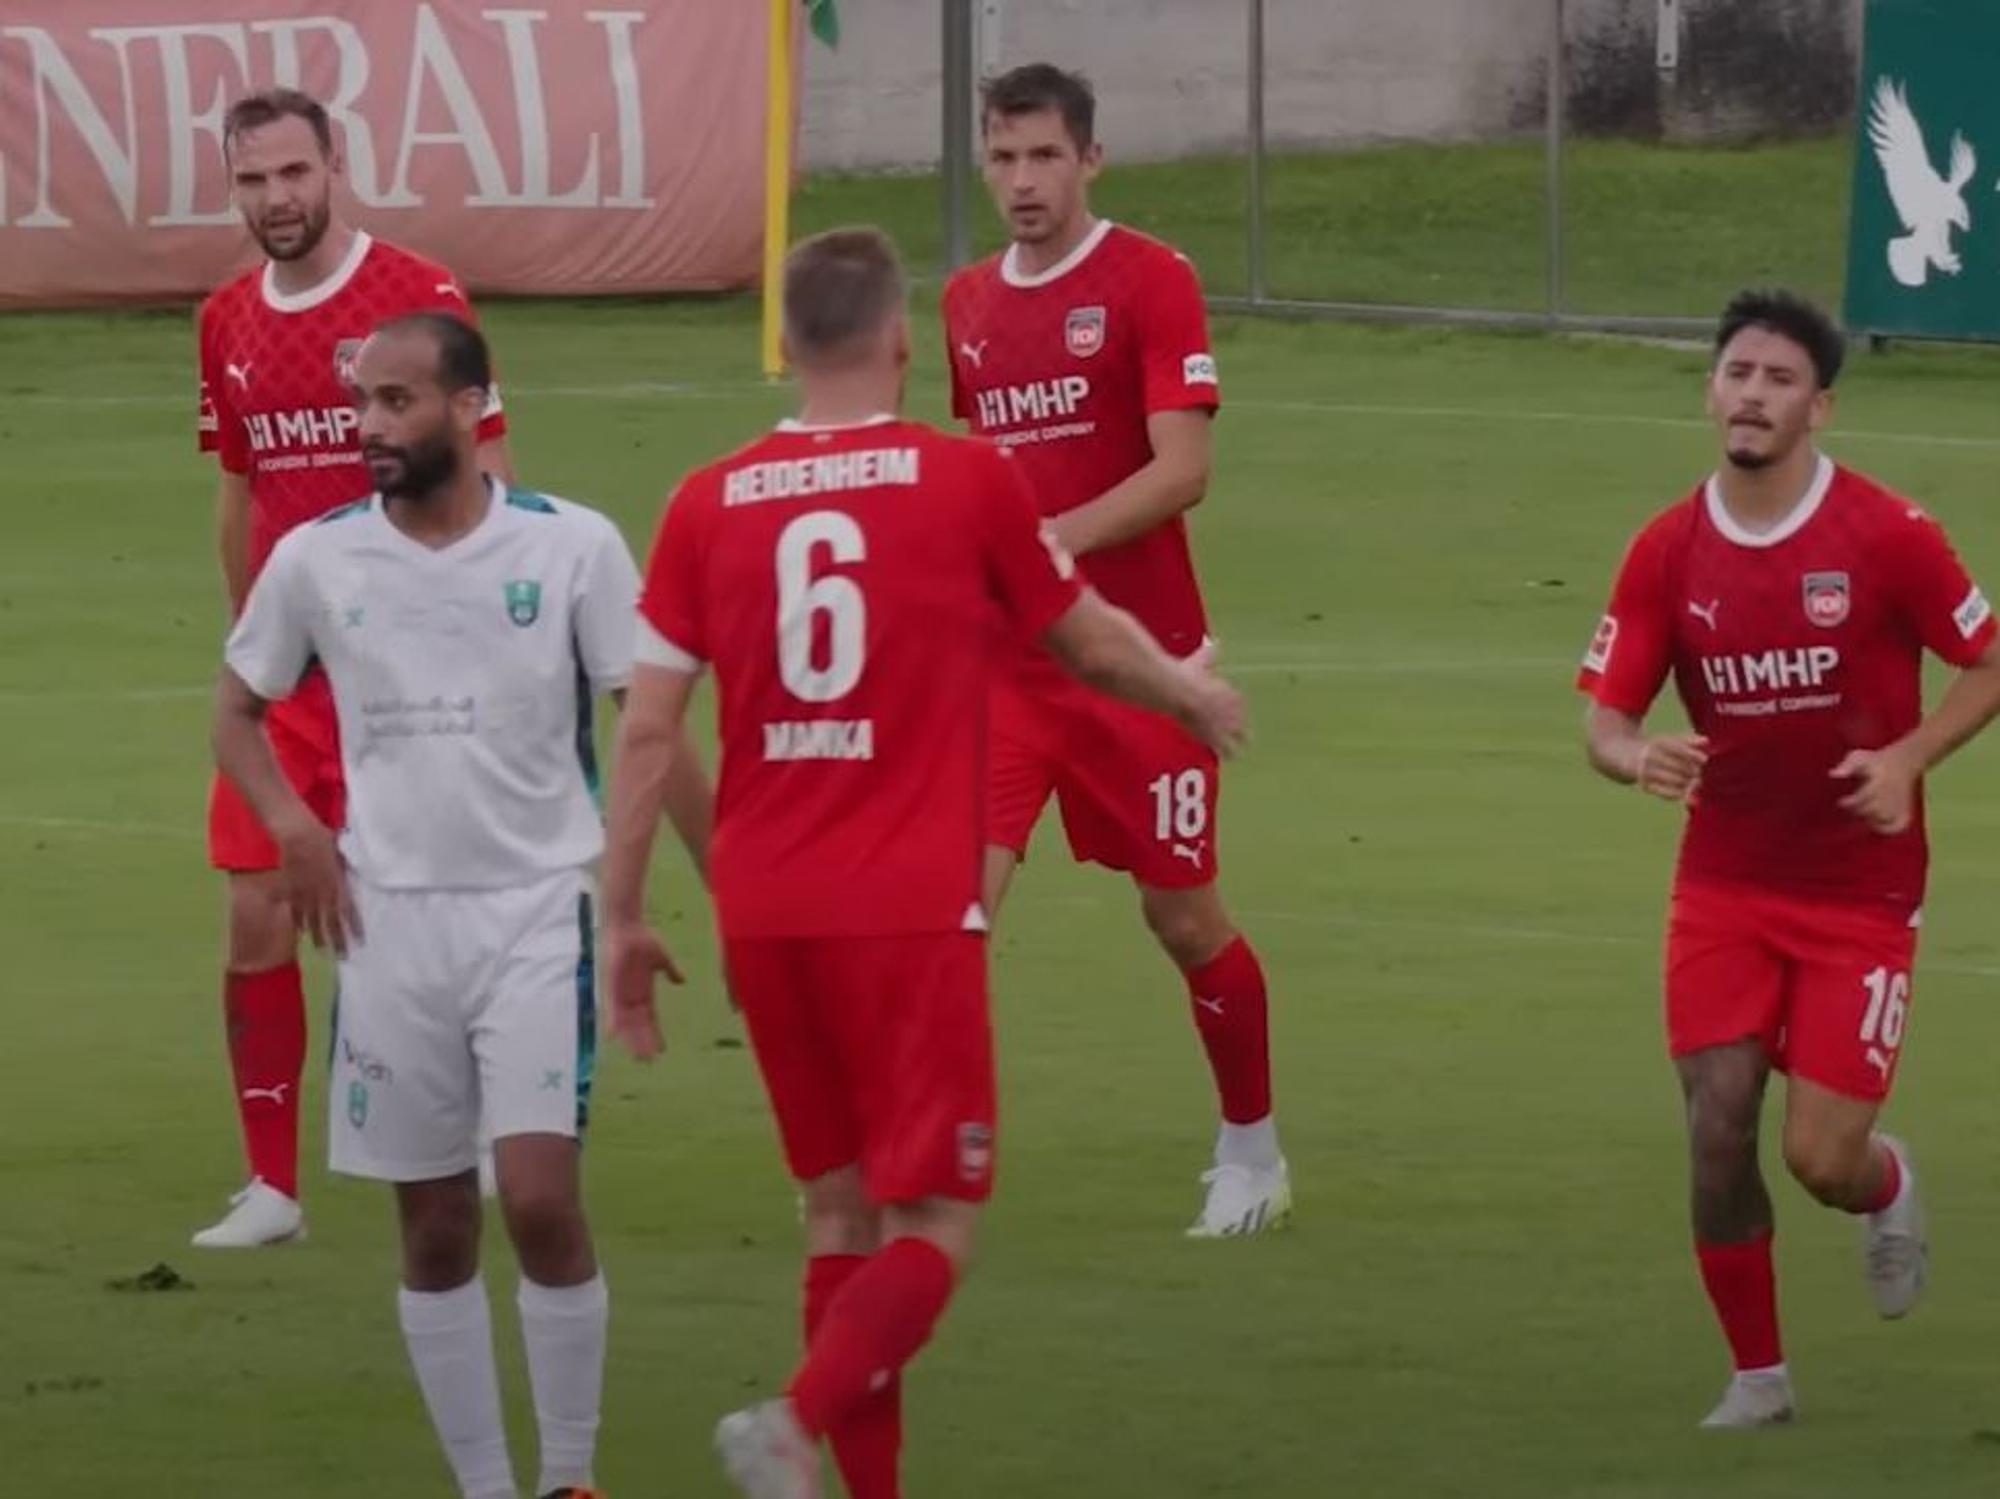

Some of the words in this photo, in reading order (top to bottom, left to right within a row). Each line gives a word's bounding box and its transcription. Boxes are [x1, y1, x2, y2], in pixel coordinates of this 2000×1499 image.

[0, 3, 655, 228] NERALI
[276, 407, 358, 447] MHP
[1008, 376, 1089, 422] MHP
[723, 447, 919, 507] HEIDENHEIM
[776, 510, 867, 702] 6
[1741, 646, 1839, 692] MHP
[1148, 768, 1206, 840] 18
[1860, 966, 1908, 1048] 16
